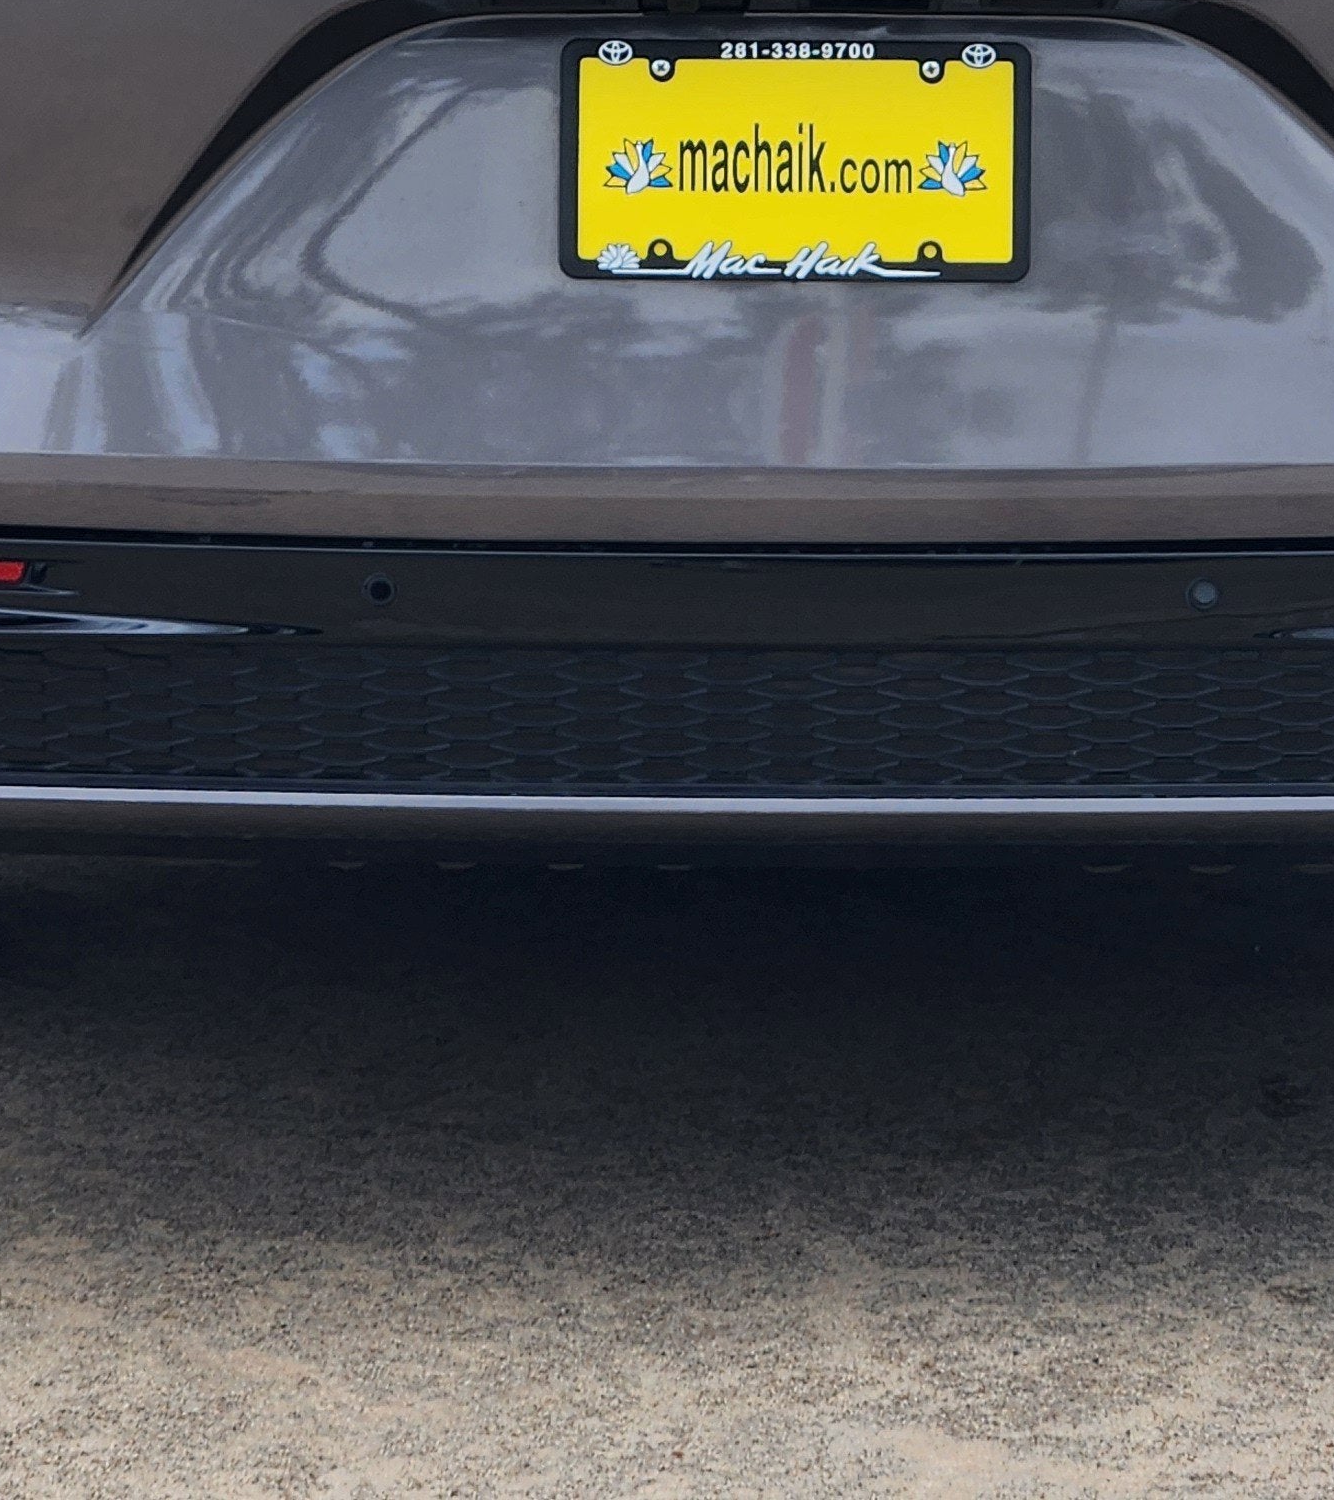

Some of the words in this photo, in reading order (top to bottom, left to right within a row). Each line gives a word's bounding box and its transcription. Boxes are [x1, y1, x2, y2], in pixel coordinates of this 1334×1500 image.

[720, 41, 876, 60] 281-338-9700
[677, 122, 914, 195] machaik.com
[683, 240, 782, 280] Mac
[783, 240, 885, 280] Haik
